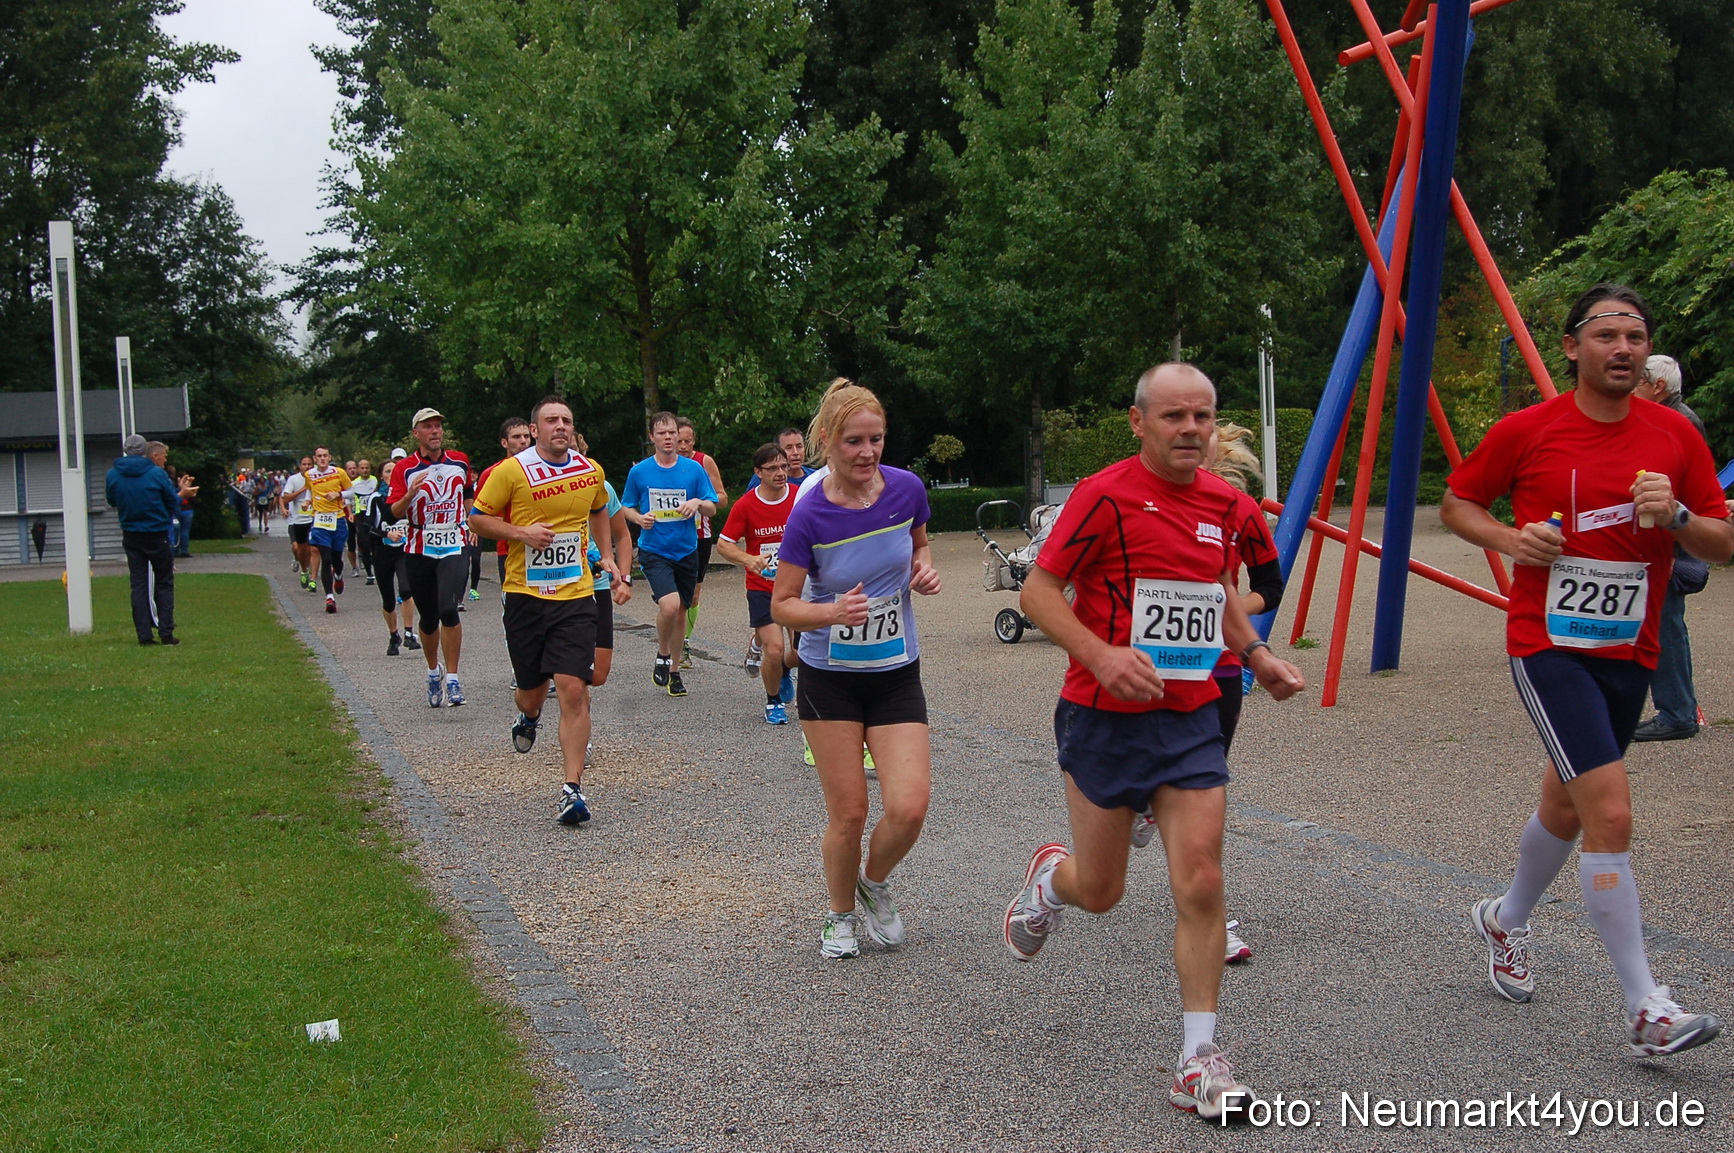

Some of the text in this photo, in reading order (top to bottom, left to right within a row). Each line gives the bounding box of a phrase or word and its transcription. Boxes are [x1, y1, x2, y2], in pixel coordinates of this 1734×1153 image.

[532, 476, 599, 502] MAX BÖGL
[426, 501, 456, 512] BIMBO
[657, 497, 680, 509] 116
[426, 532, 456, 545] 2513
[532, 545, 576, 566] 2962
[544, 571, 566, 579] Julian
[1552, 563, 1634, 580] PARTL Neumarkt
[1137, 588, 1213, 602] PARTL Neumarkt
[1556, 578, 1640, 616] 2287
[1143, 604, 1215, 642] 2560
[1569, 621, 1618, 637] Richard
[1158, 650, 1202, 666] Herbert
